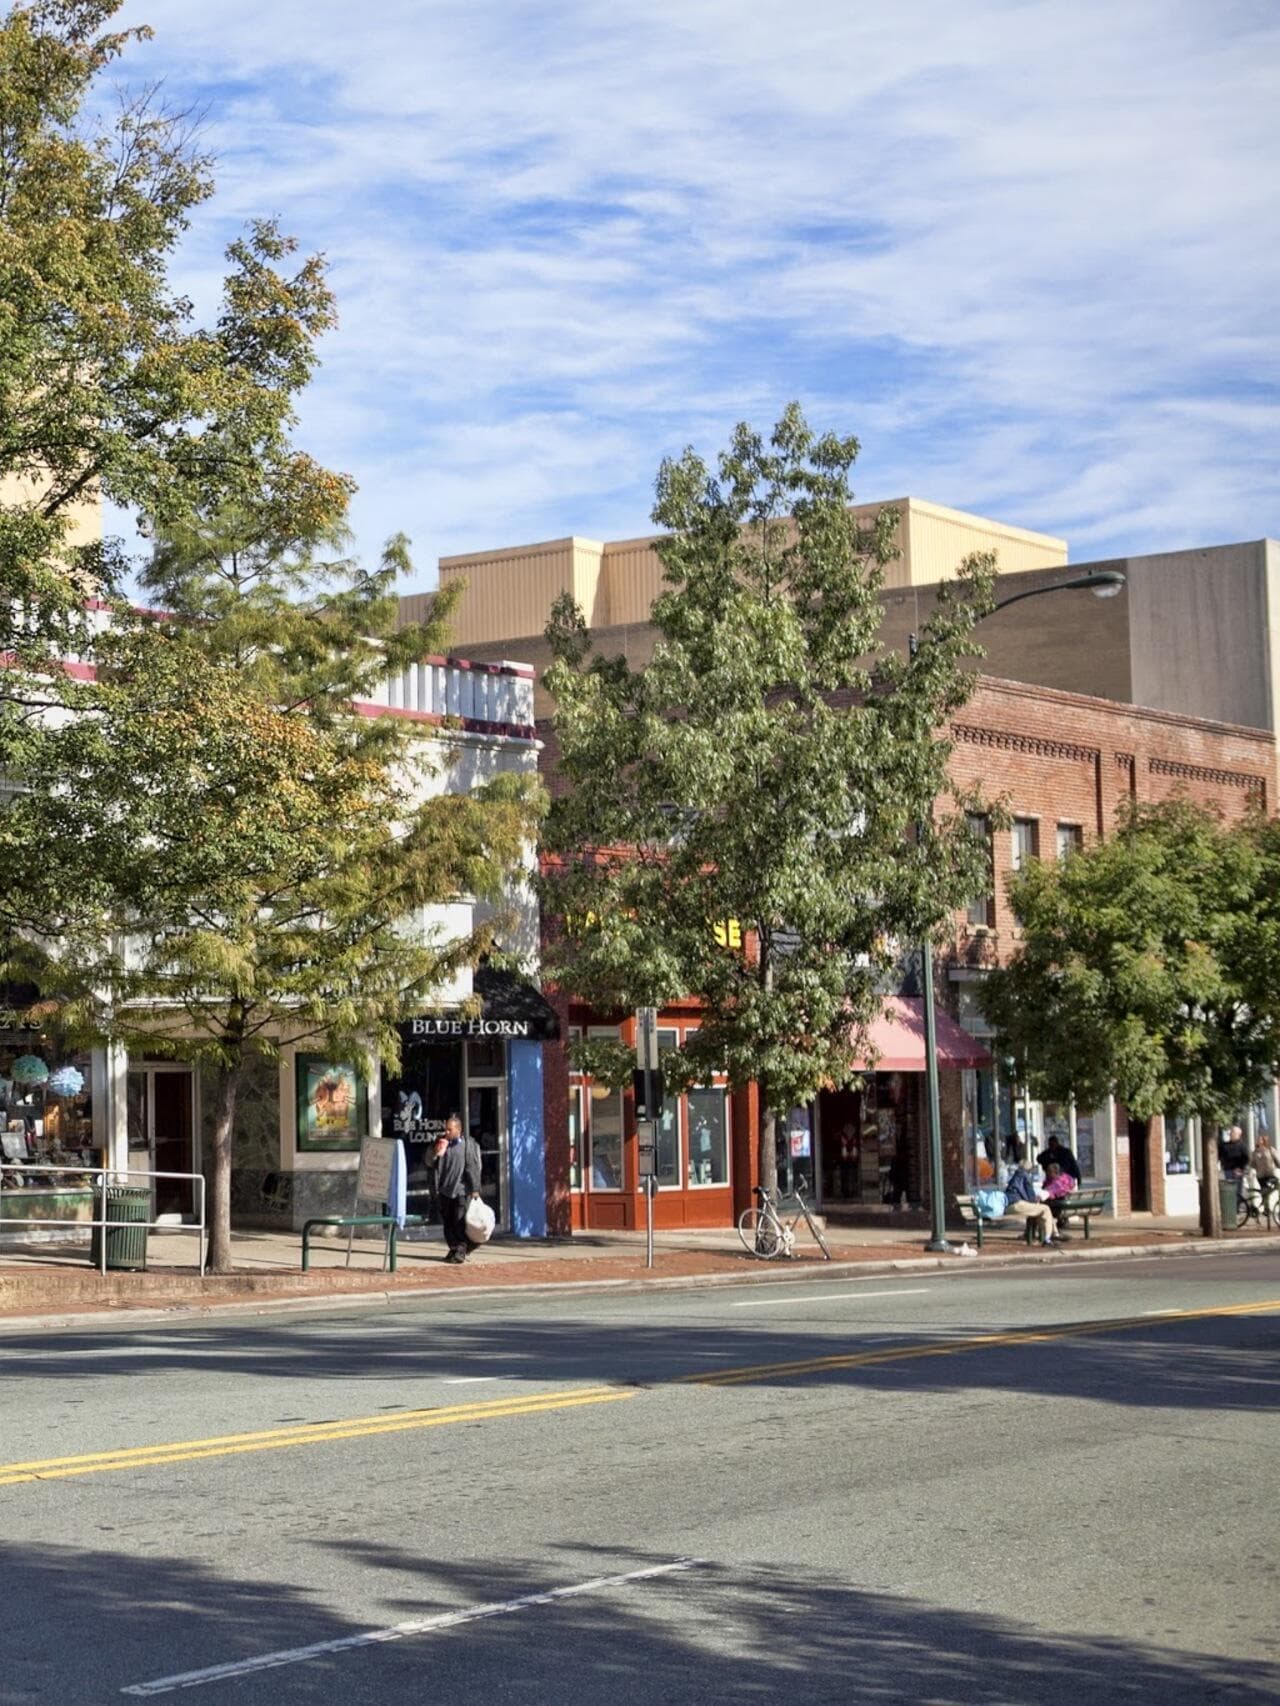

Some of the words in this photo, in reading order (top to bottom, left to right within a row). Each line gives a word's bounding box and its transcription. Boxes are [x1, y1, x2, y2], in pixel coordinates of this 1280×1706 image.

[411, 1019, 463, 1035] BLUE
[467, 1019, 529, 1036] HORN
[393, 1119, 417, 1132] BLE
[409, 1131, 446, 1144] LOUN
